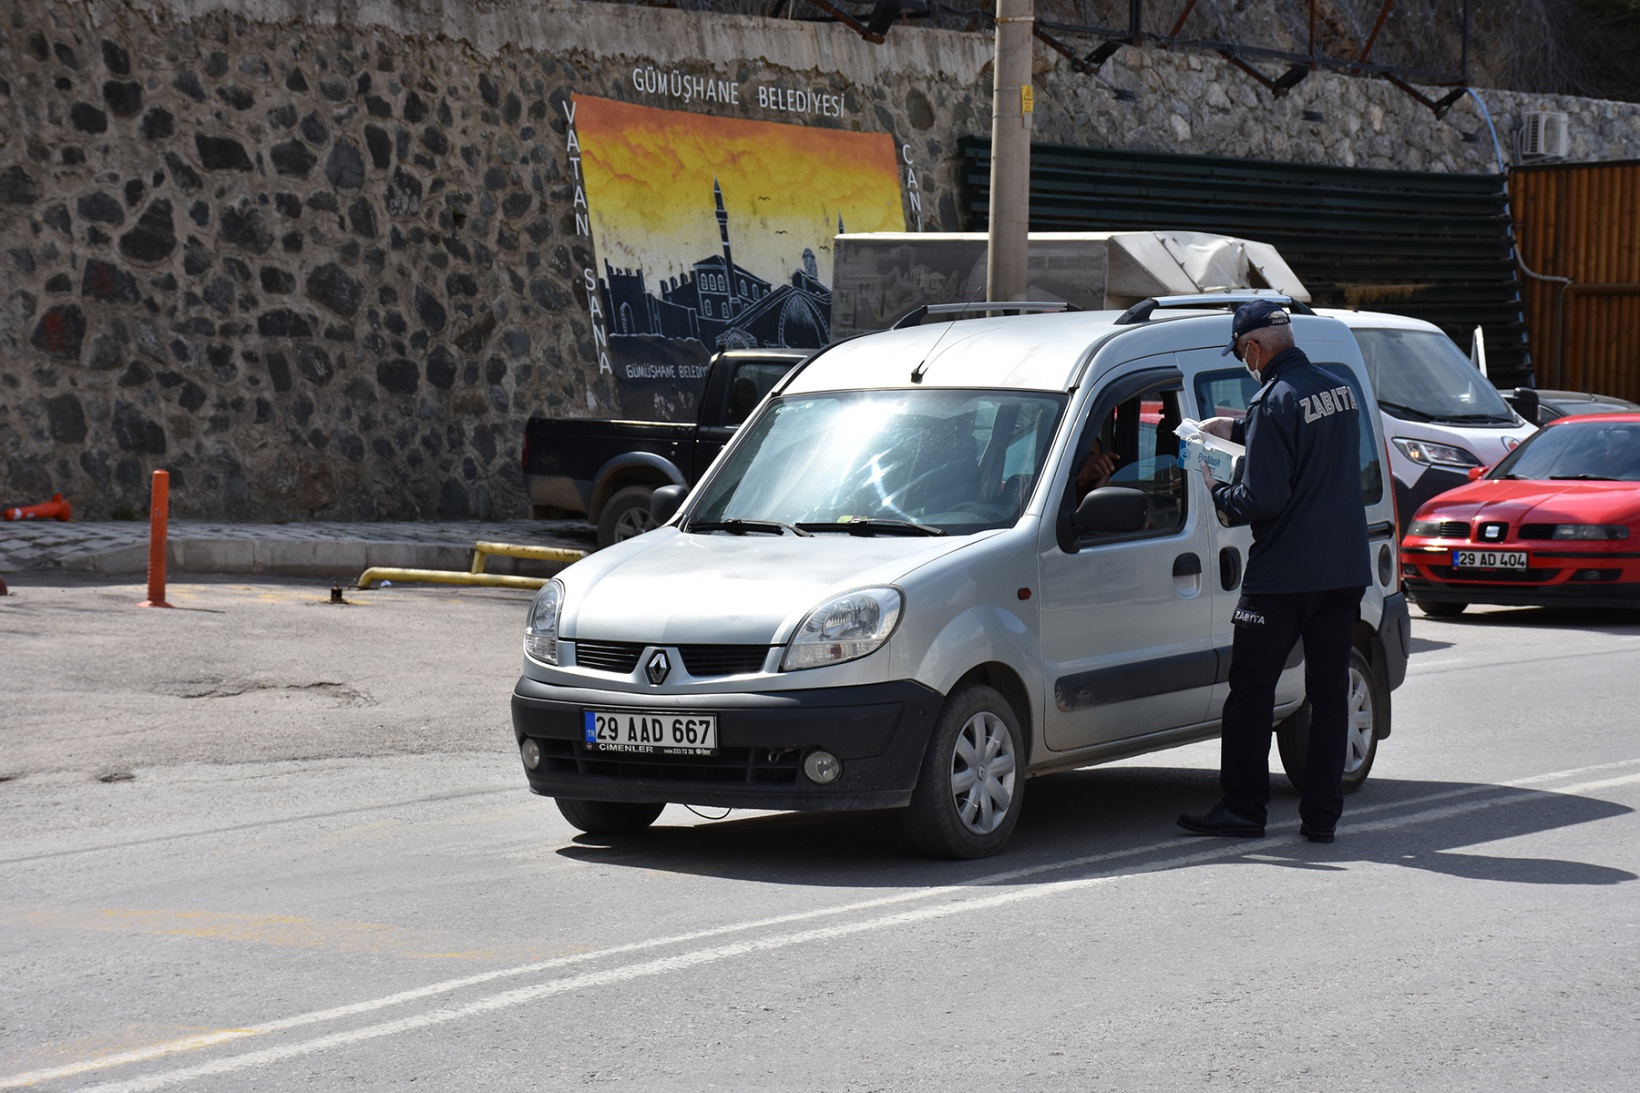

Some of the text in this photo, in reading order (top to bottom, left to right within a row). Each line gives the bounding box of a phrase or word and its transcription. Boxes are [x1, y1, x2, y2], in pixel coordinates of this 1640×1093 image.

[632, 66, 845, 118] GÜMÜŞHANE BELEDİYESİ
[562, 100, 613, 376] VATAN SANA
[625, 363, 676, 379] GÜMÜŞHANE
[1299, 385, 1358, 424] ZABITA
[1459, 552, 1526, 567] 29 AD 404
[1234, 610, 1266, 625] ZABITA
[587, 729, 596, 738] TR
[596, 716, 711, 745] 29 AAD 667
